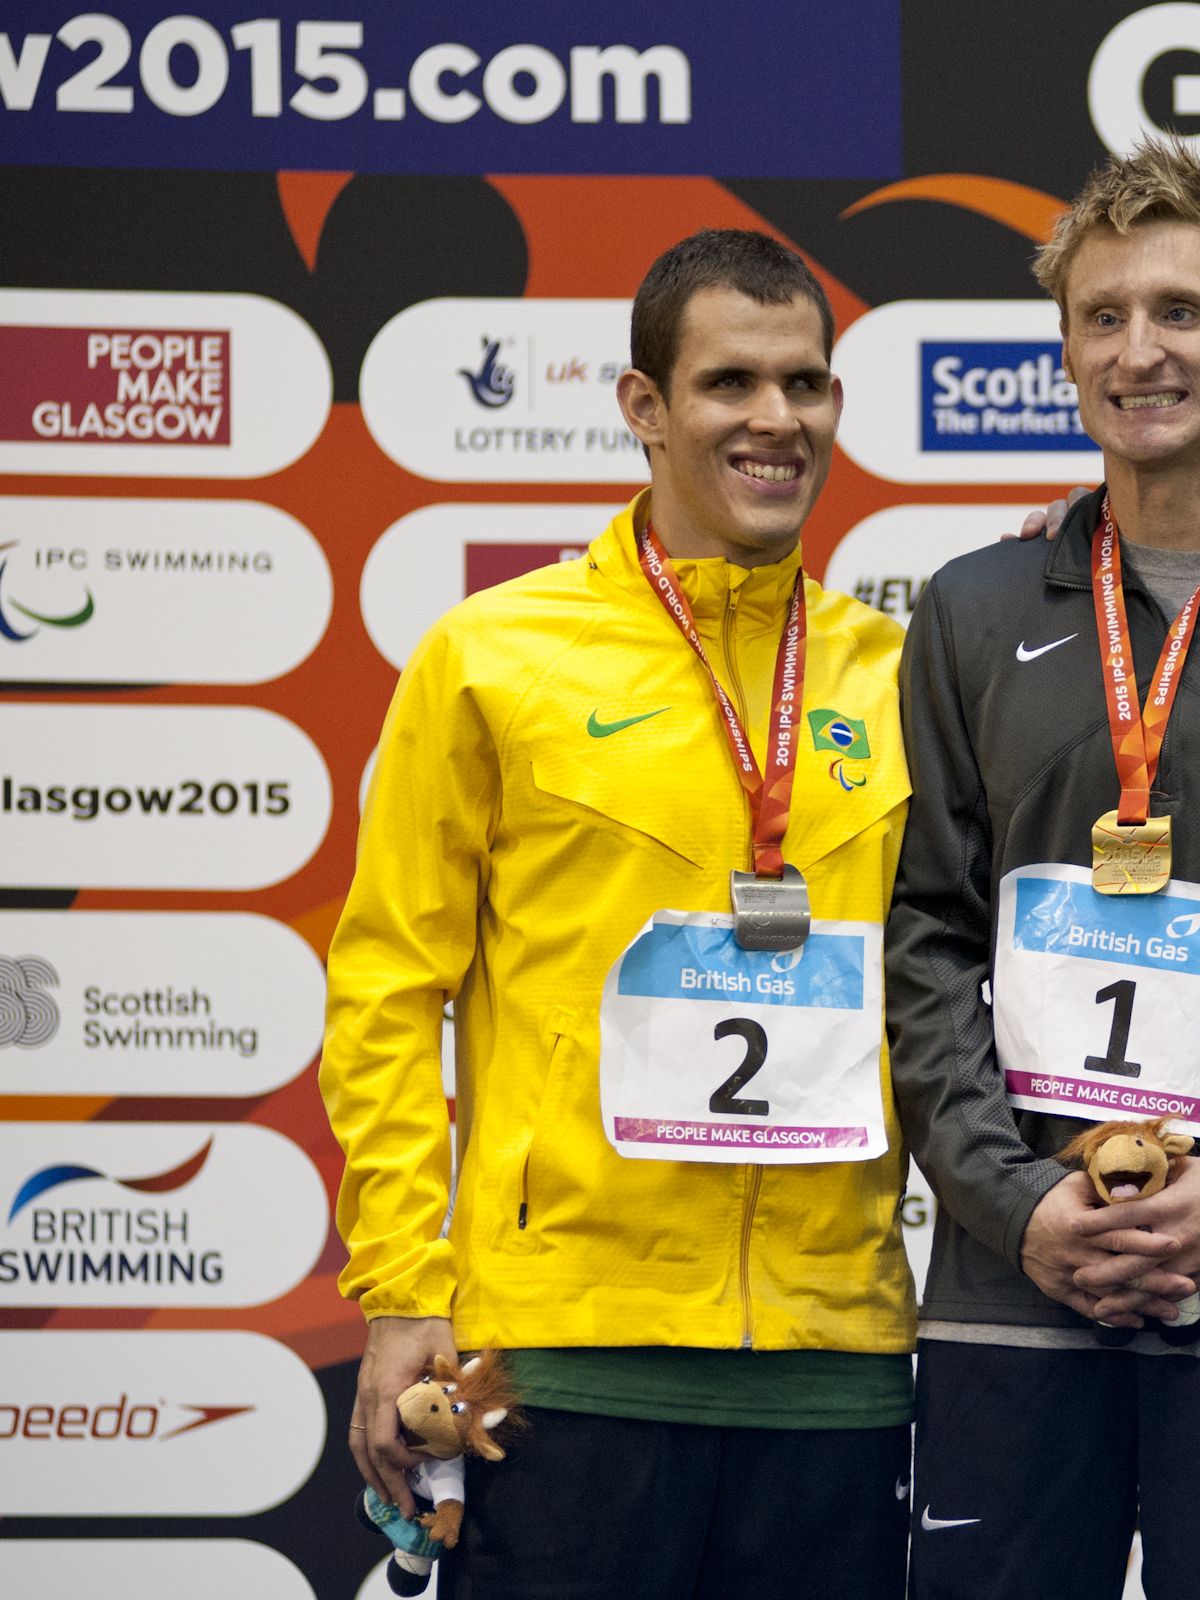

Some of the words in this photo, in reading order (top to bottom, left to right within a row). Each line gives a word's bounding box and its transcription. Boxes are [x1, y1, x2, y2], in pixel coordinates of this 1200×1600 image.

[0, 12, 691, 125] w2015.com
[88, 333, 223, 370] PEOPLE
[546, 356, 590, 384] uk
[117, 370, 223, 405] MAKE
[931, 353, 1079, 408] Scotla
[32, 400, 223, 440] GLASGOW
[932, 407, 979, 435] The
[981, 407, 1070, 436] Perfect
[455, 428, 577, 452] LOTTERY
[34, 548, 89, 570] IPC
[104, 549, 274, 573] SWIMMING
[1101, 521, 1114, 572] WORLD
[658, 575, 691, 631] WORLD
[1101, 572, 1122, 654] SWIMMING
[781, 624, 799, 703] SWIMMING
[1113, 656, 1127, 683] IPC
[779, 704, 793, 730] IPC
[1115, 684, 1131, 721] 2015
[775, 731, 791, 767] 2015
[2, 775, 291, 821] lasgow2015
[1068, 925, 1141, 955] British
[1146, 937, 1189, 962] Gas
[680, 968, 752, 993] British
[756, 973, 796, 996] Gas
[84, 986, 211, 1017] Scottish
[84, 1019, 259, 1058] Swimming
[1084, 979, 1142, 1079] 1
[709, 1017, 770, 1117] 2
[1030, 1078, 1075, 1098] PEOPLE
[1076, 1085, 1119, 1105] MAKE
[1120, 1092, 1196, 1116] GLASGOW
[656, 1125, 708, 1141] PEOPLE
[711, 1128, 751, 1144] MAKE
[753, 1130, 826, 1145] GLASGOW
[32, 1208, 189, 1244] BRITISH
[900, 1195, 938, 1228] G
[0, 1250, 224, 1284] SWIMMING
